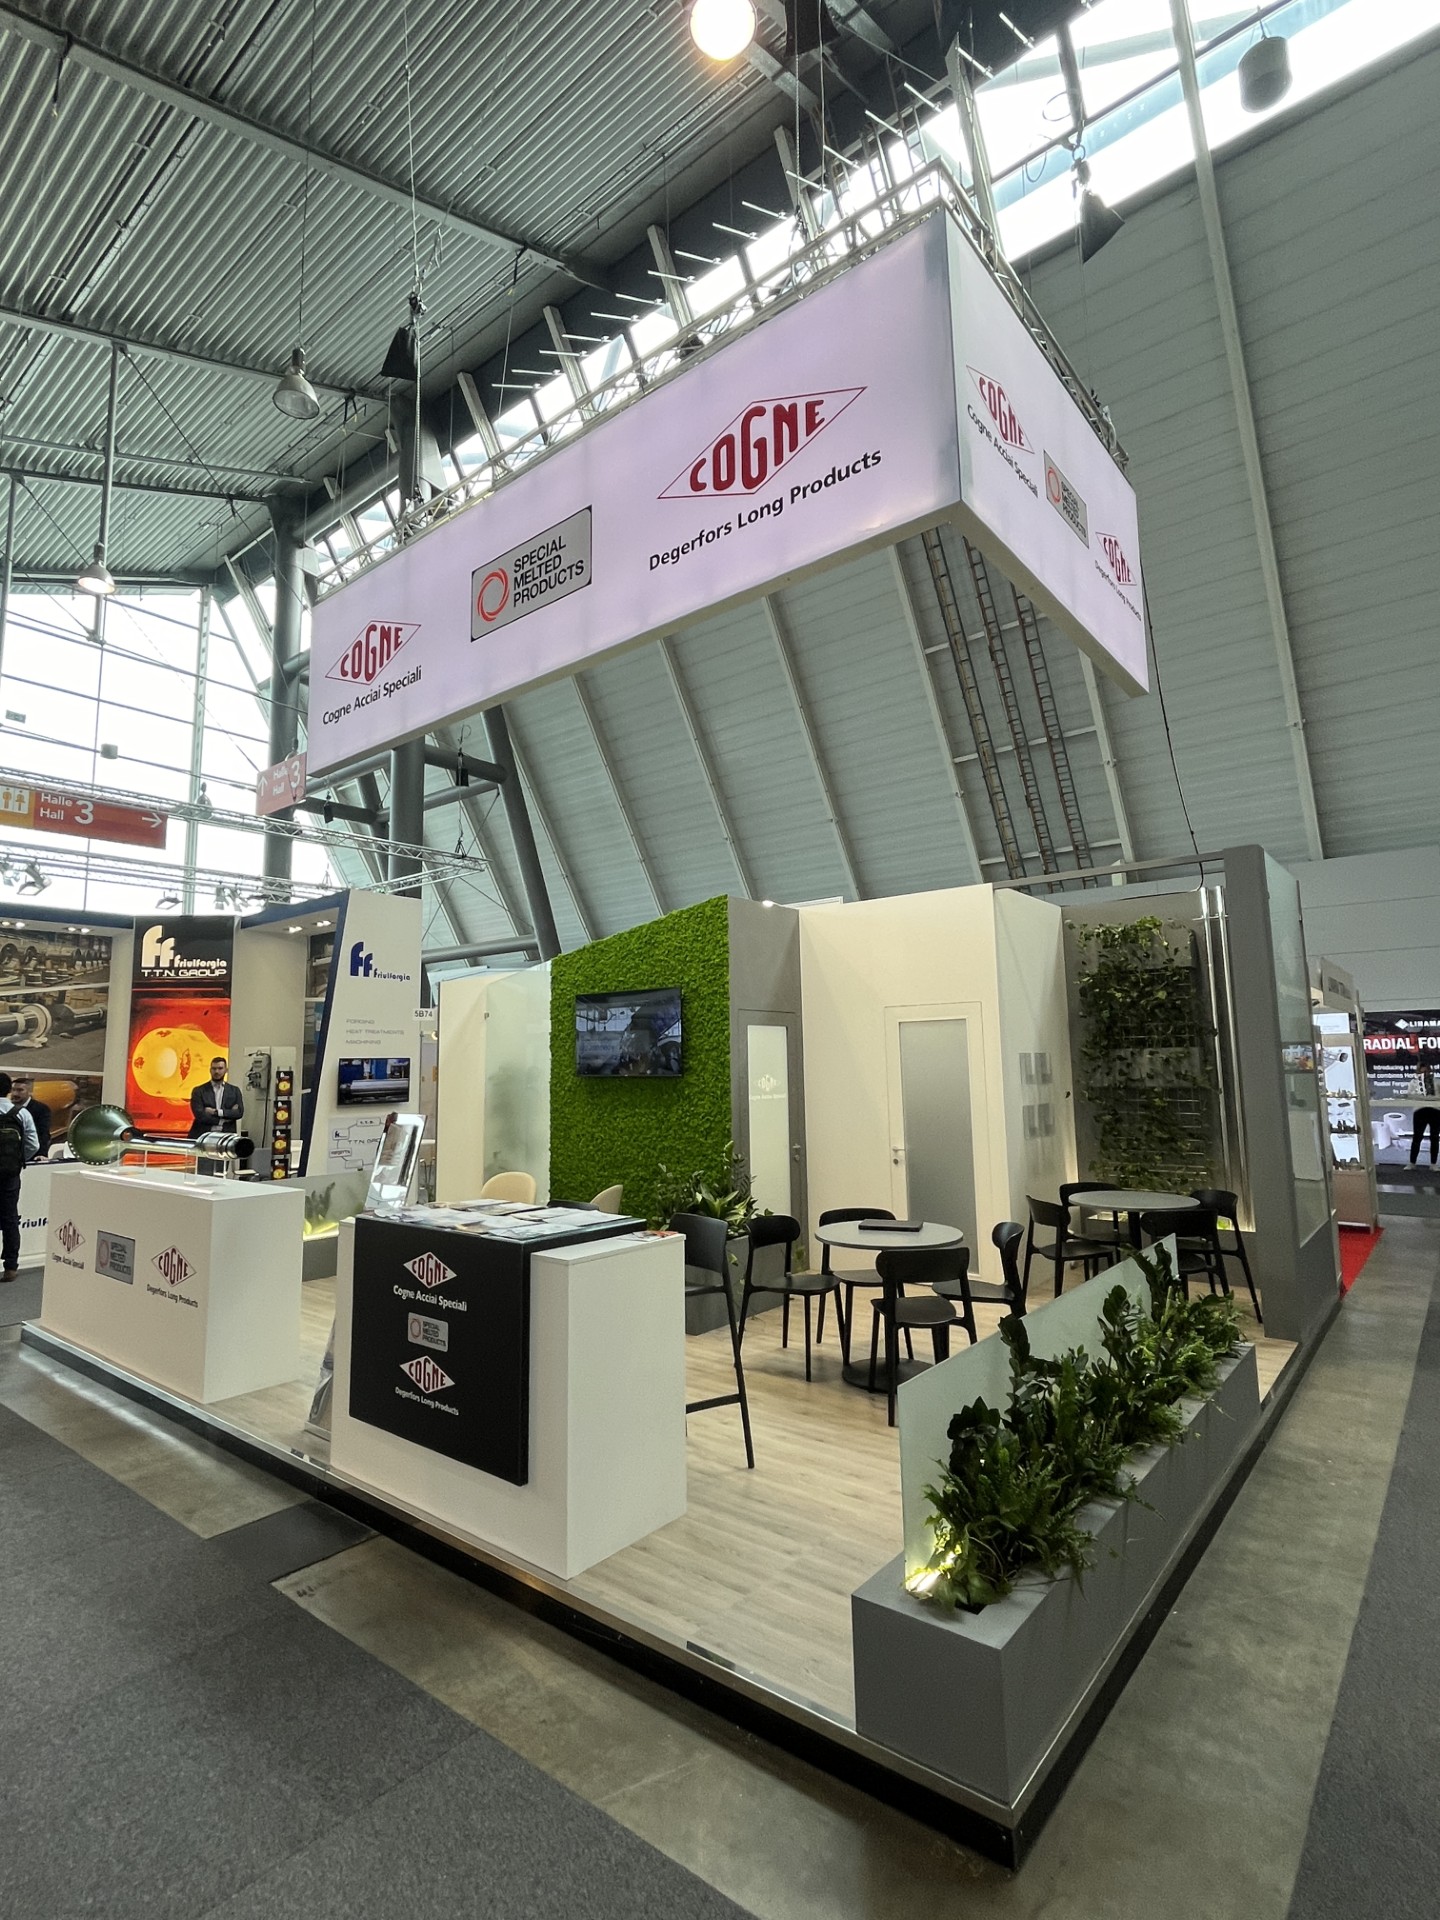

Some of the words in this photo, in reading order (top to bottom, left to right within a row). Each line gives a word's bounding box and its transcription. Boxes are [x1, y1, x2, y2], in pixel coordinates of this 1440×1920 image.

[979, 377, 1025, 447] COGNE
[690, 399, 825, 492] COGNE
[967, 404, 992, 442] Cogne
[1014, 461, 1039, 499] Speciali
[649, 521, 732, 571] Degerfors
[738, 497, 784, 529] Long
[790, 450, 882, 504] Products
[513, 535, 566, 573] SPECIAL
[1103, 537, 1131, 582] COGNE
[513, 554, 562, 591] MELTED
[513, 560, 584, 607] PRODUCTS
[340, 624, 403, 682] COGNE
[322, 704, 352, 725] Cogne
[354, 685, 381, 711] Acciai
[383, 665, 422, 698] Speciali
[291, 760, 300, 788] 3
[40, 807, 64, 821] Hall
[41, 793, 73, 807] Halle
[74, 800, 94, 825] 3
[174, 955, 227, 969] friulforgia
[178, 969, 227, 977] GROUP
[373, 968, 411, 982] friulforgia
[414, 1010, 433, 1018] 5B74
[1363, 1038, 1415, 1050] RADIAL
[59, 1221, 80, 1251] COGNE
[158, 1247, 189, 1285] COGNE
[412, 1253, 448, 1287] COGNE
[147, 1283, 167, 1298] Degerfors
[179, 1294, 198, 1308] Products
[393, 1285, 415, 1300] Cogne
[416, 1290, 437, 1304] Acciai
[438, 1295, 467, 1312] Speciali
[408, 1358, 446, 1394] COGNE
[395, 1386, 420, 1402] Degerfors
[421, 1396, 435, 1409] Long
[435, 1400, 459, 1416] Products
